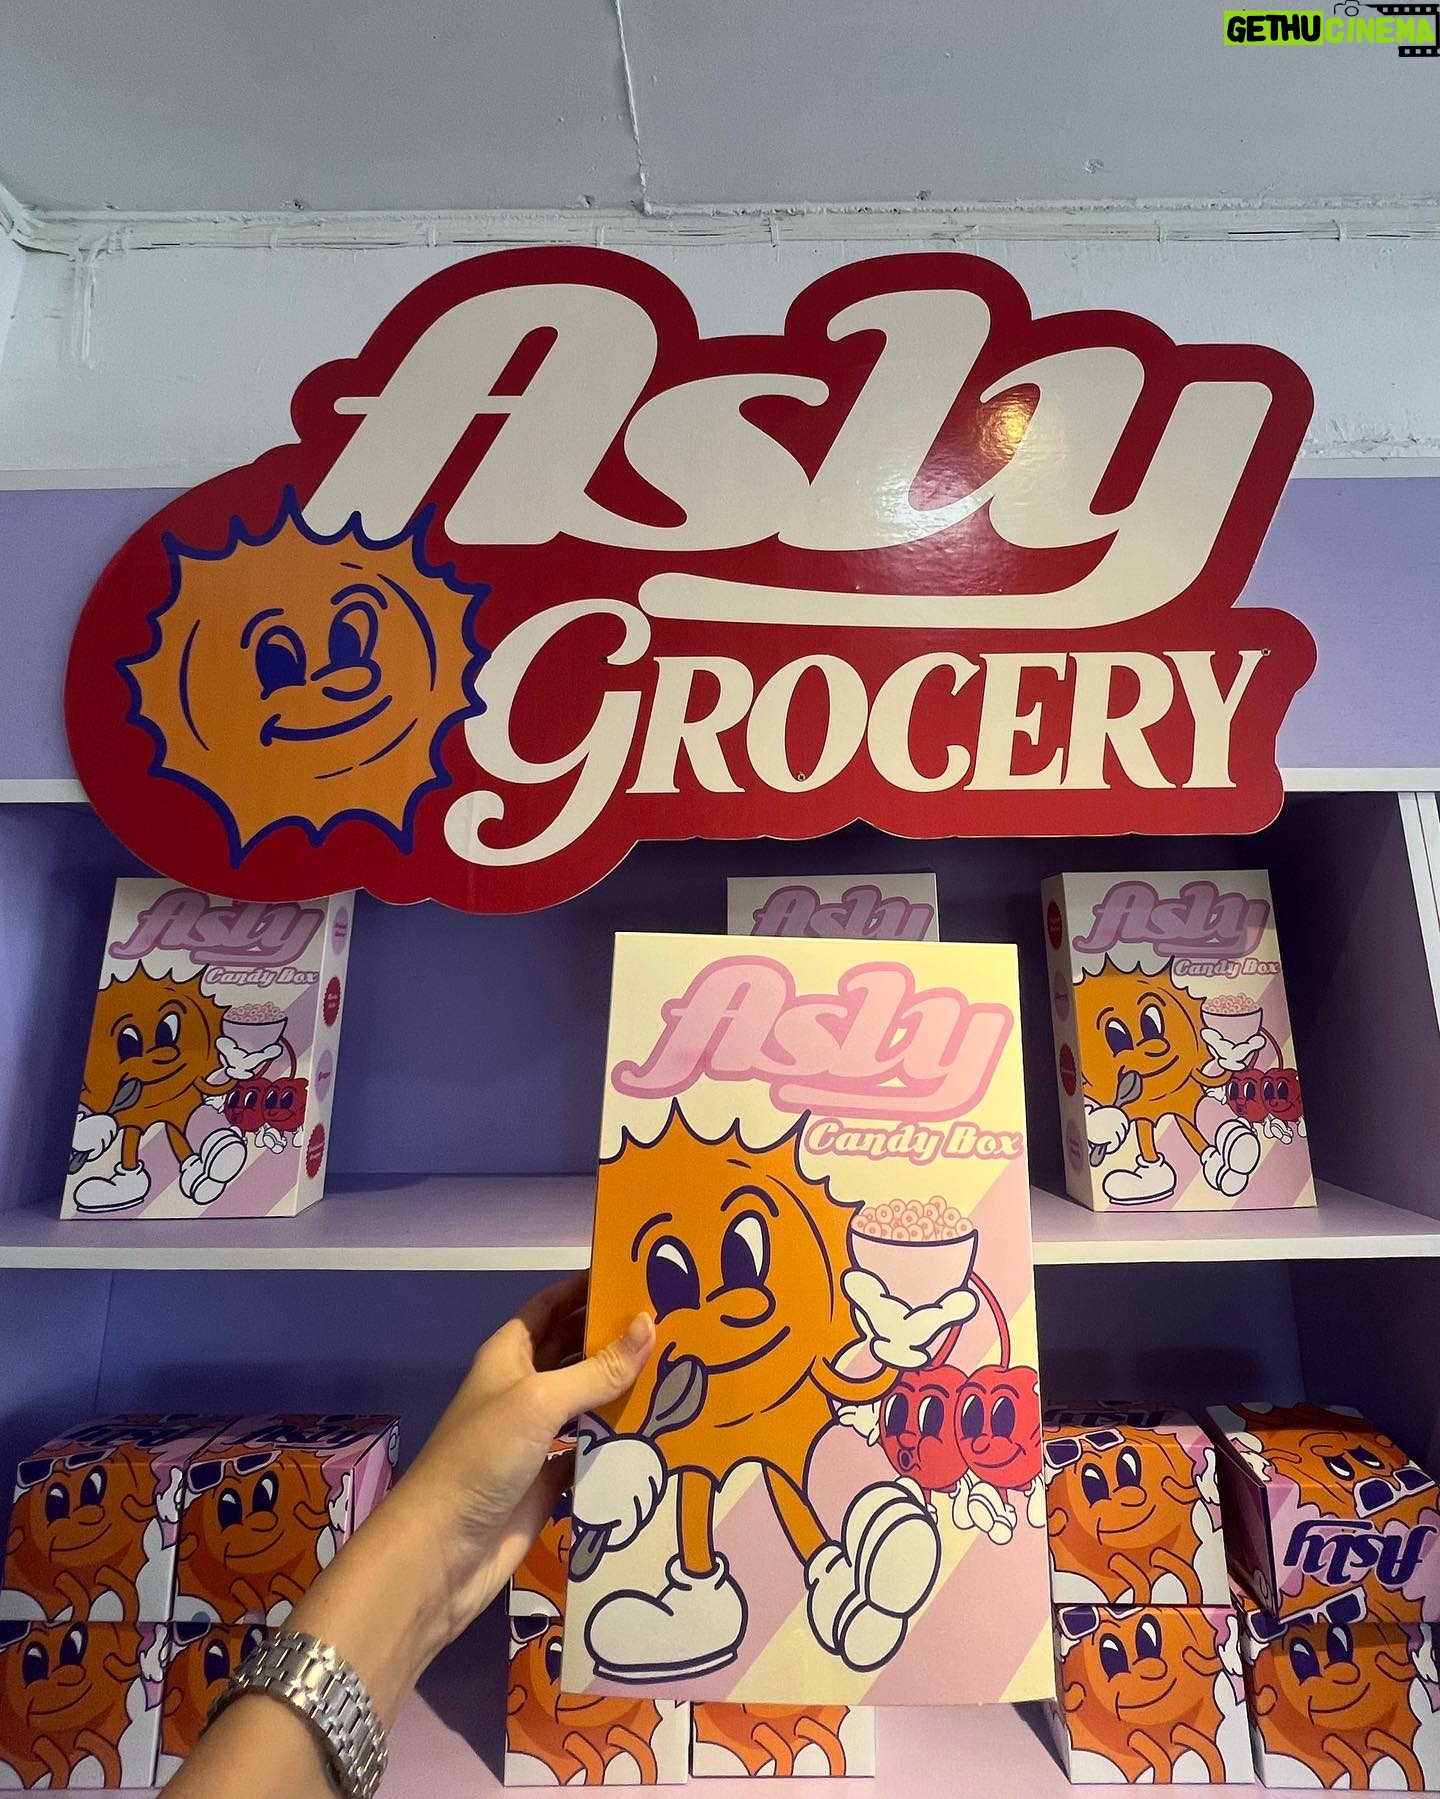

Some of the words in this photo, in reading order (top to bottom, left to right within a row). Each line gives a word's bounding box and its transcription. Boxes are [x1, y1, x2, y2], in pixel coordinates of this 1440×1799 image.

[303, 282, 1273, 629] Asly
[109, 888, 325, 967] Asly
[1072, 881, 1270, 958] Asly
[206, 967, 278, 988] Candy
[275, 967, 319, 985] Box
[1174, 959, 1243, 979] Candy
[1241, 960, 1281, 977] Box
[611, 955, 1014, 1122] Asly
[805, 1117, 943, 1166] Candy
[943, 1121, 1024, 1160] Box
[1283, 1519, 1437, 1585] Asly
